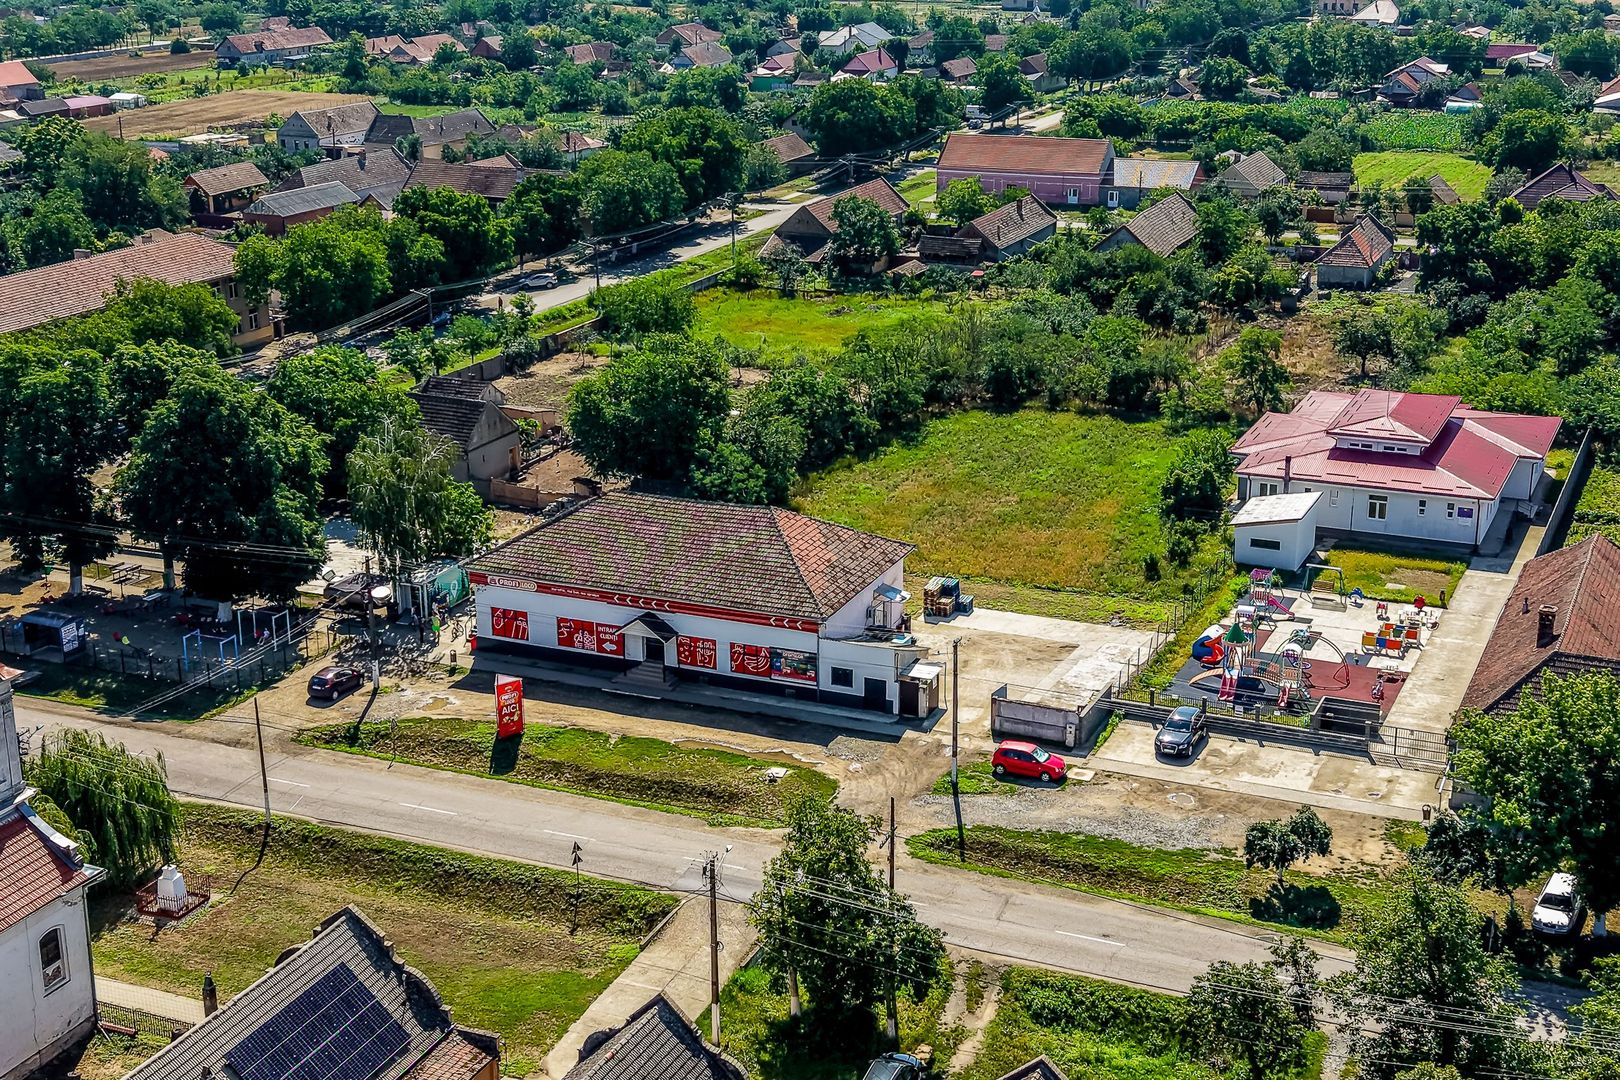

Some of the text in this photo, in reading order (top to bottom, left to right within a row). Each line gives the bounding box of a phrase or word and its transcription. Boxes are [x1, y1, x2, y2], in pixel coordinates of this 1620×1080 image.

[499, 579, 535, 590] PROFI LOCO
[501, 704, 519, 715] AICI
